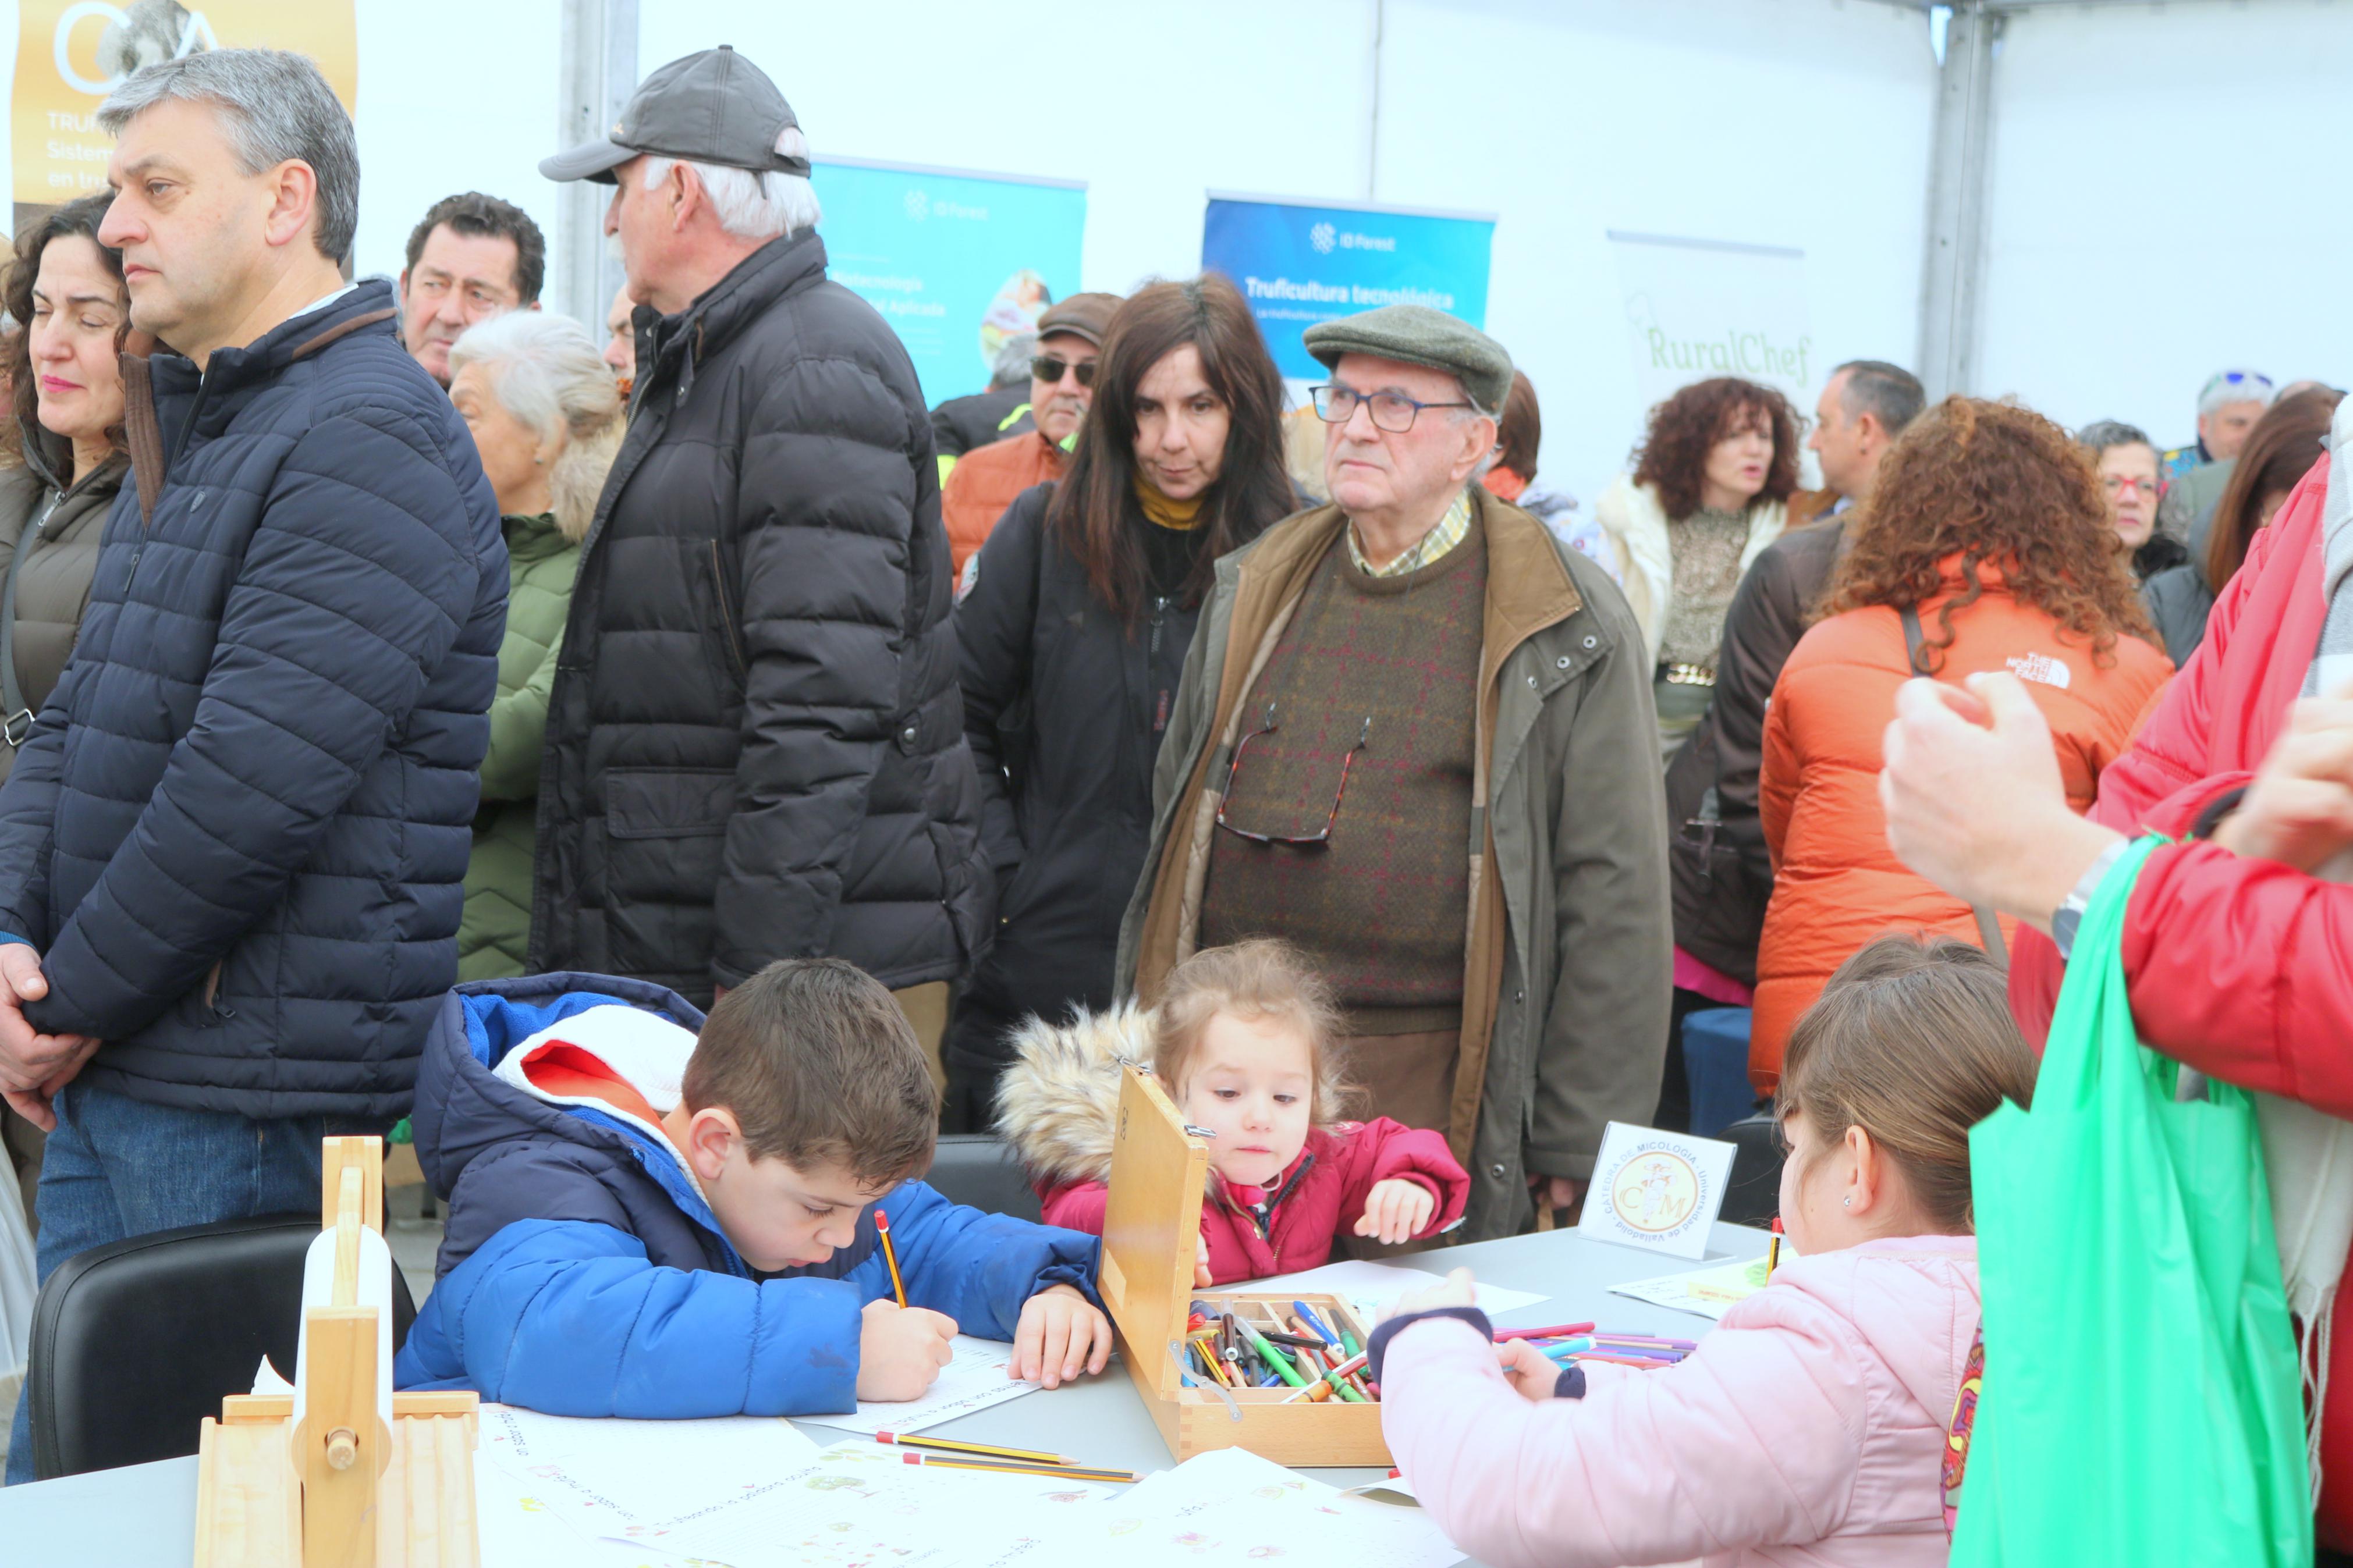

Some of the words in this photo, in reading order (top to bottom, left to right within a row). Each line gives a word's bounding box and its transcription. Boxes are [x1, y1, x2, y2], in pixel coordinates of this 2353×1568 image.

[47, 111, 97, 132] TRUF
[47, 140, 113, 161] Sistem
[48, 165, 74, 186] en
[78, 167, 108, 188] tru
[1354, 234, 1396, 252] Forest
[1245, 277, 1348, 303] Truficultura
[889, 299, 946, 318] Aplicada
[1647, 326, 1811, 389] RuralChef
[2006, 657, 2049, 675] NORTH
[2027, 652, 2051, 666] THE
[2015, 669, 2047, 683] FACE
[1620, 1149, 1636, 1162] DE
[1614, 1220, 1666, 1243] Valladolid
[739, 1481, 785, 1501] palabra
[785, 1466, 824, 1481] oculta
